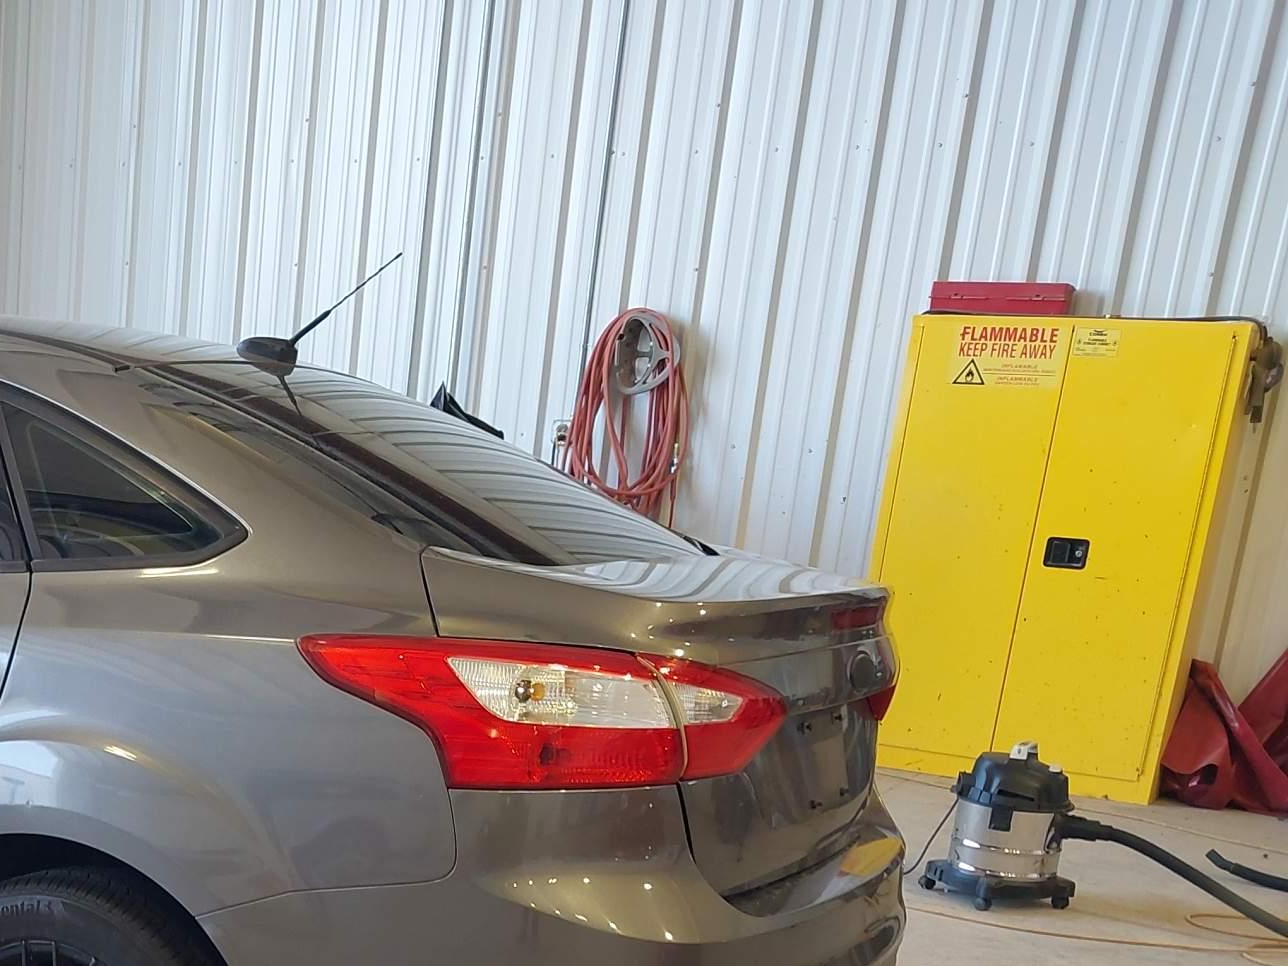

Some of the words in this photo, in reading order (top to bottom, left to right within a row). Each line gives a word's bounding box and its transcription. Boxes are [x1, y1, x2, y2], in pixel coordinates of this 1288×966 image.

[961, 326, 1060, 344] FLAMMABLE
[958, 342, 988, 357] KEEP
[990, 343, 1018, 358] FIRE
[1019, 344, 1057, 360] AWAY
